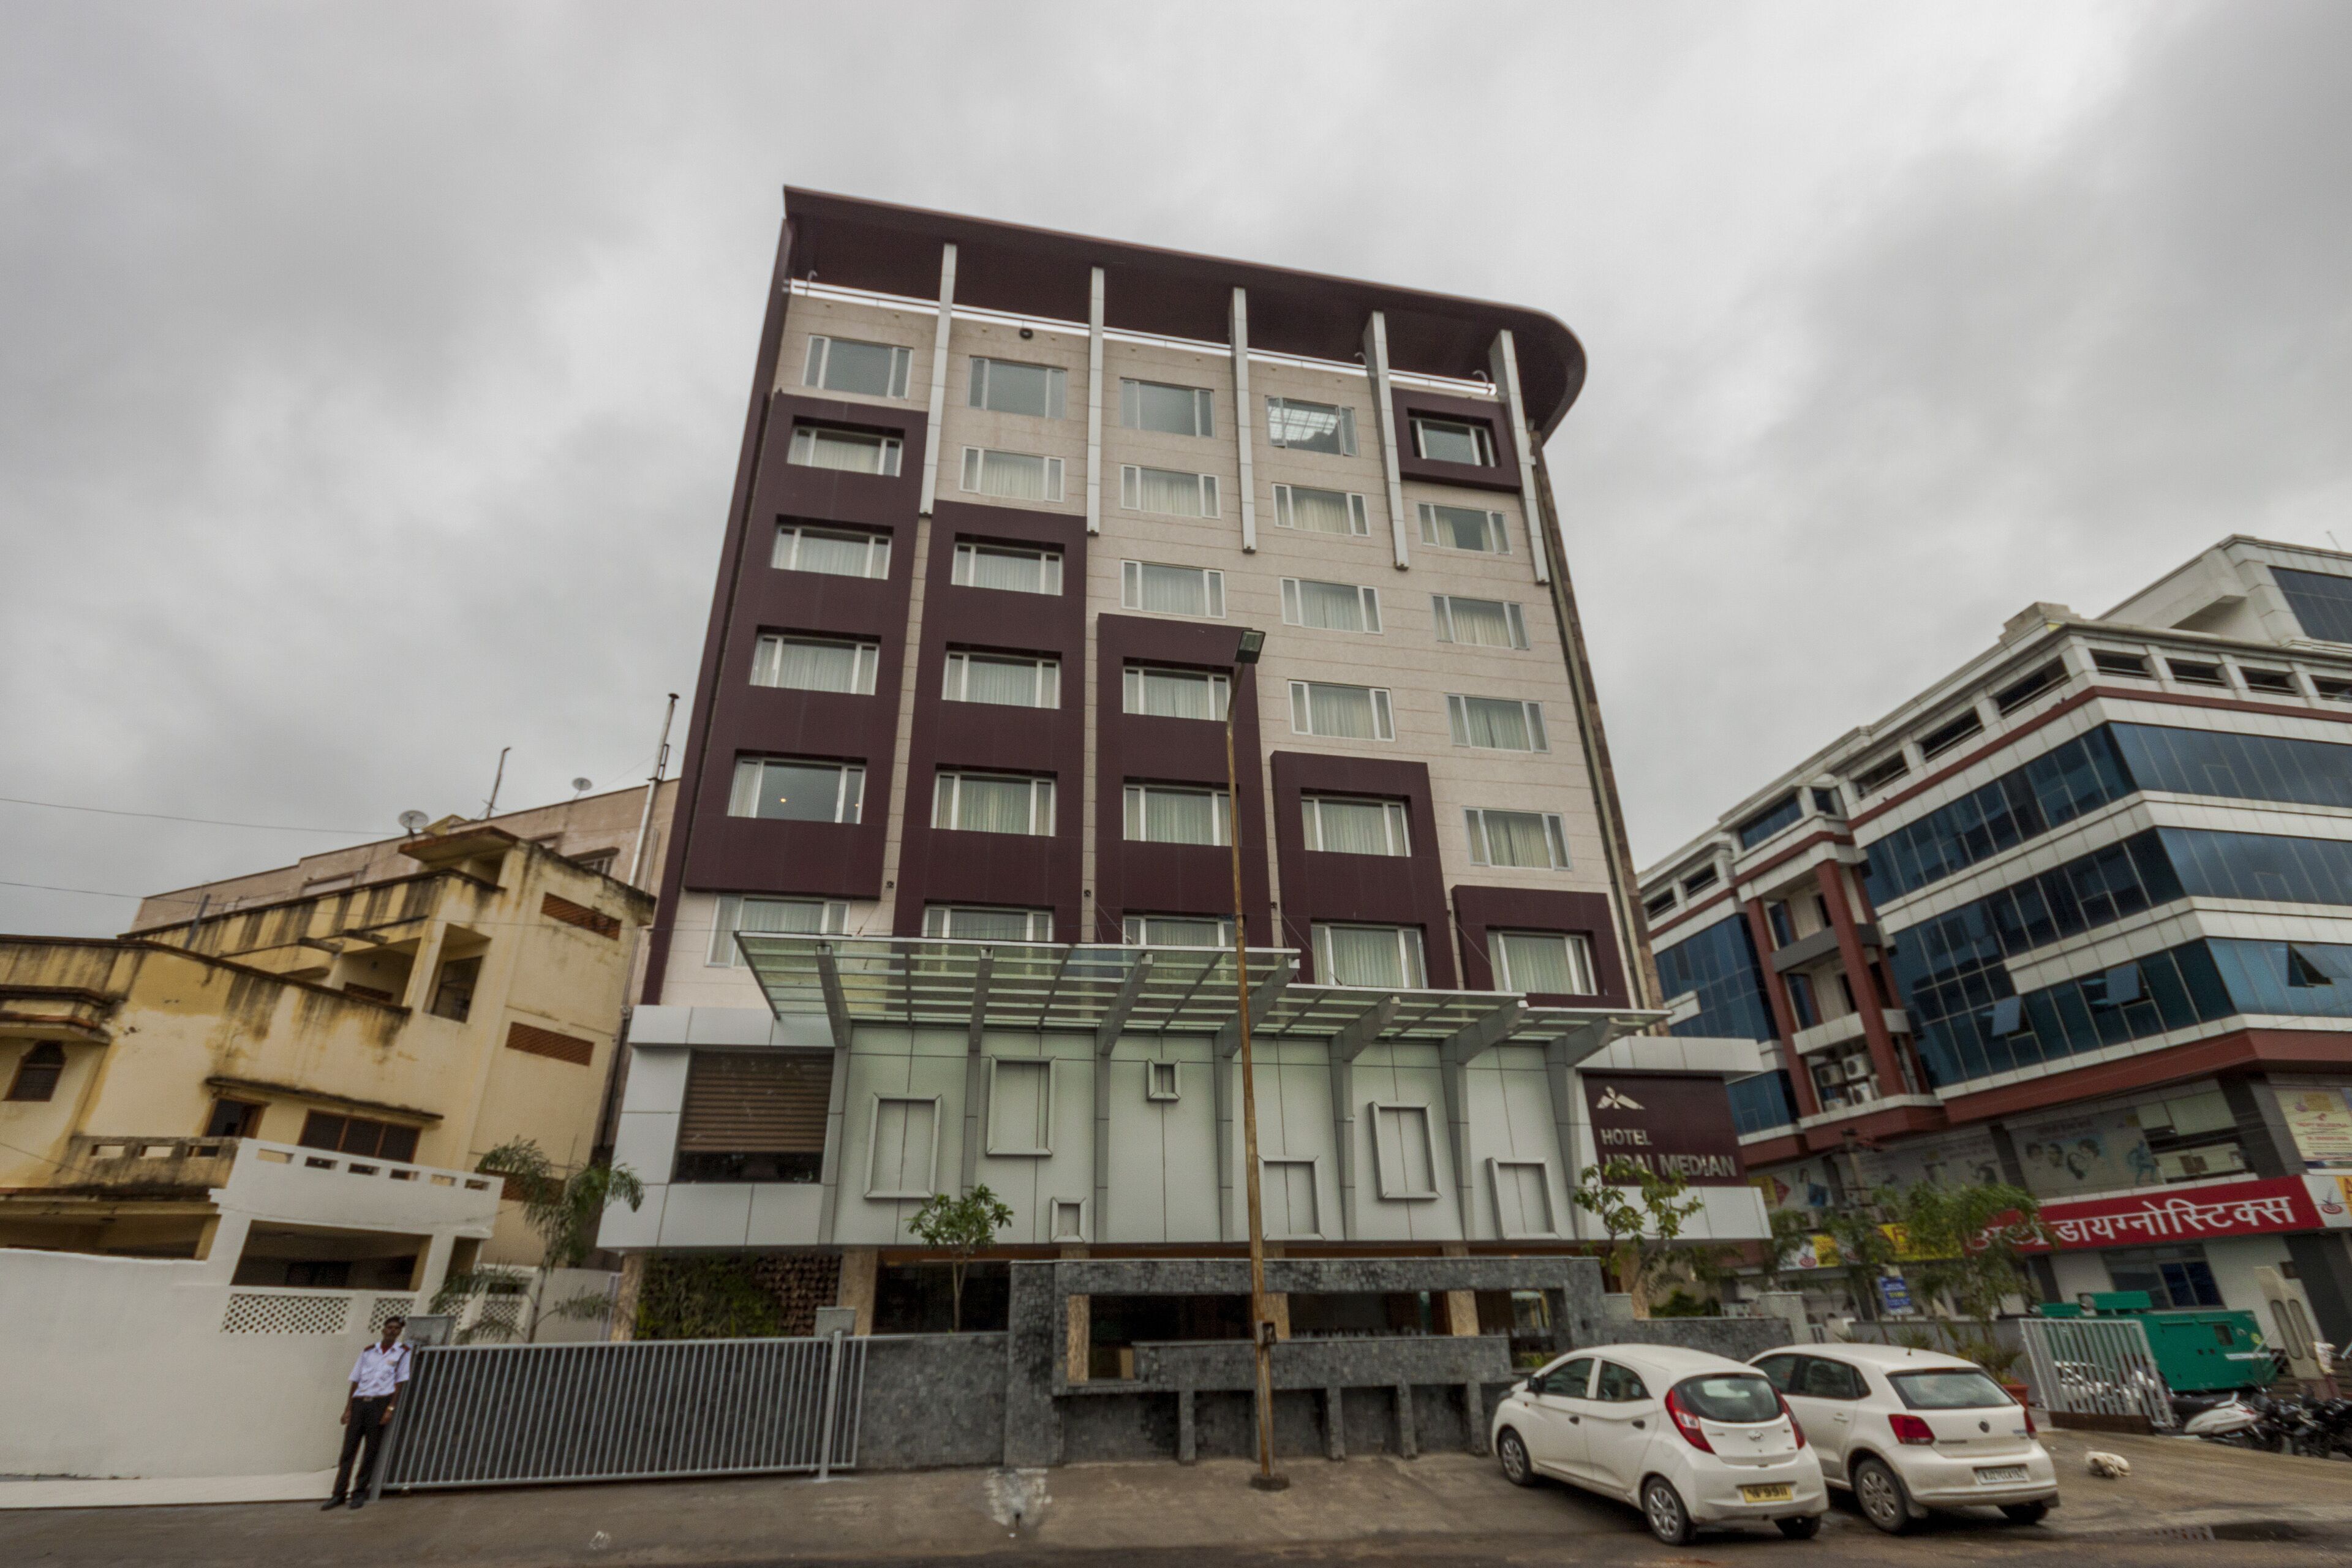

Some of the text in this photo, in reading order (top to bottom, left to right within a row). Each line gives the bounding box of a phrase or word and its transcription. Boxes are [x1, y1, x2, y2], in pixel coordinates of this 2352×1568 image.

[1600, 1128, 1653, 1146] HOTEL
[1657, 1153, 1737, 1177] MEDIAN
[2051, 1197, 2296, 1243] डायग्नोस्टिक्स
